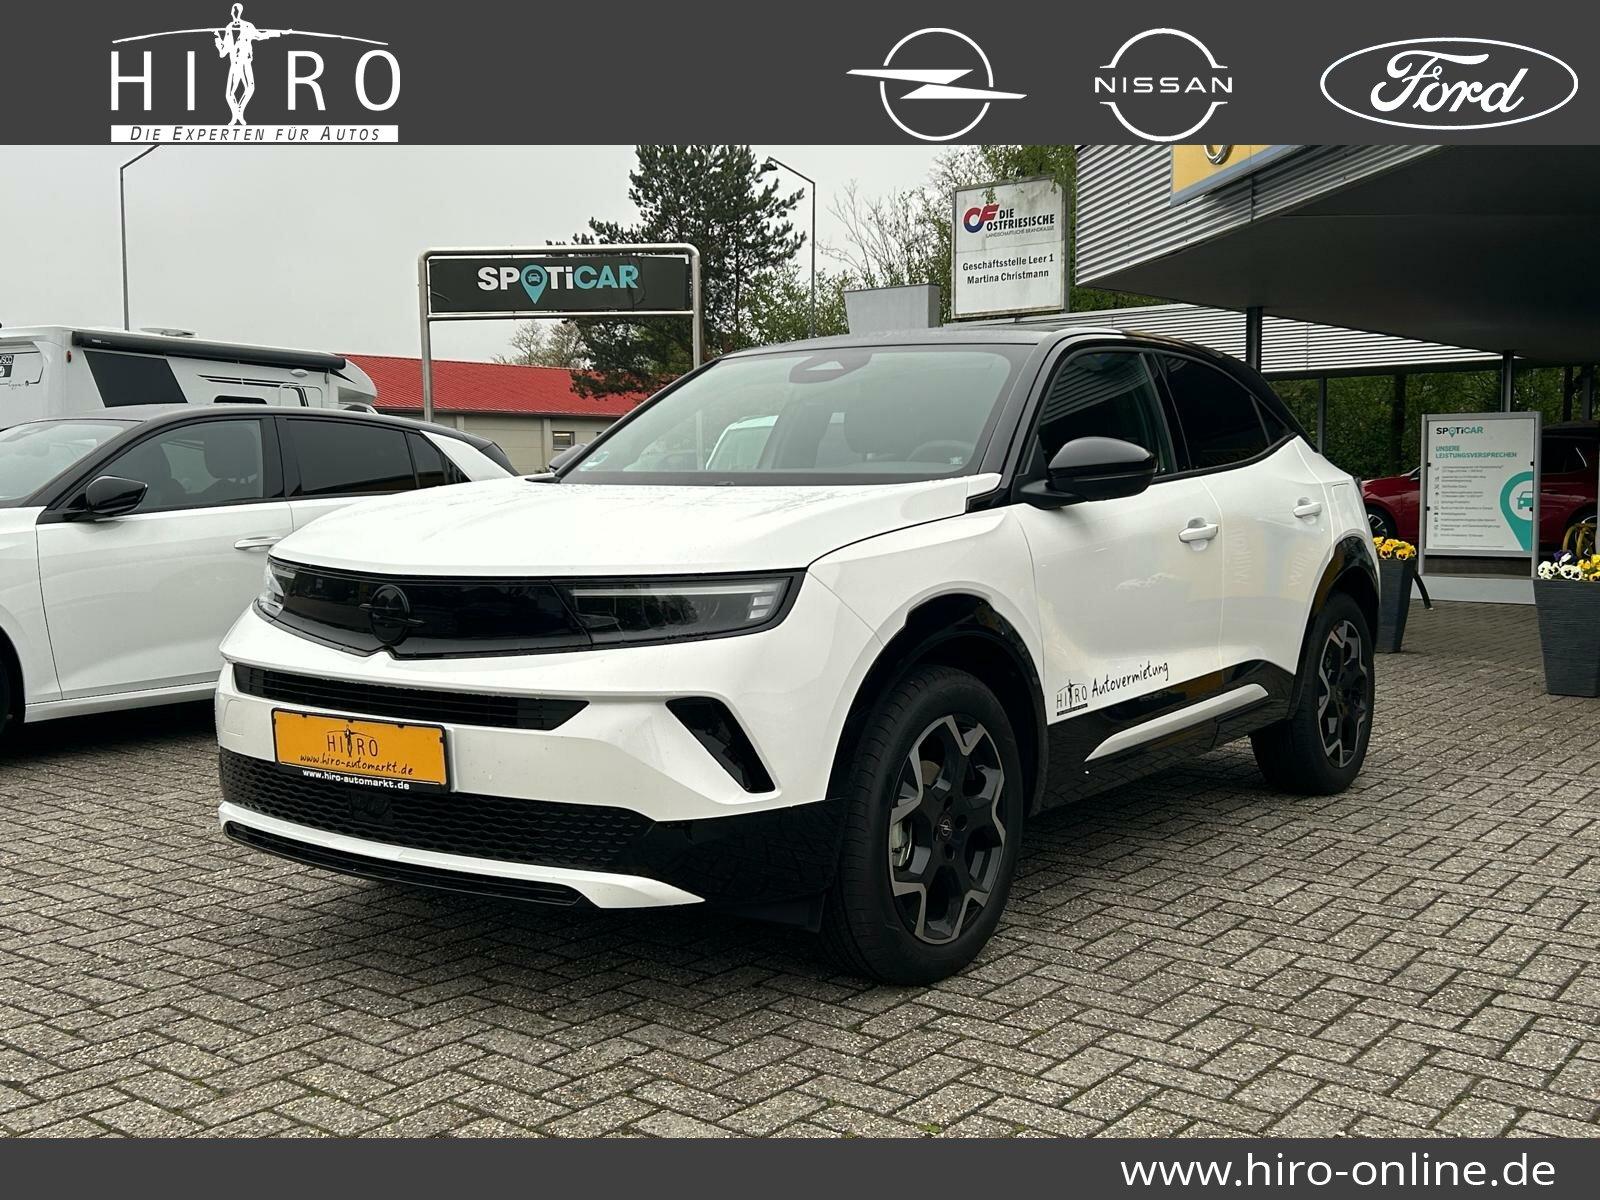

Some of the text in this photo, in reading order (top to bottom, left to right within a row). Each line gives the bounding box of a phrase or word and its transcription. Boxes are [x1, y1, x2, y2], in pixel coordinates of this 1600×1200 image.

[986, 214, 1055, 231] OSTFRIESISCHE
[1000, 208, 1014, 219] DIE
[962, 253, 1054, 271] Geschäftsstelle Leer 1
[967, 270, 1049, 285] Martina Christmann
[1056, 660, 1169, 708] HIRO Autovermietung
[326, 735, 378, 757] HIRO
[300, 753, 413, 776] www.hiro-automarkt.de
[302, 769, 410, 790] www.hiro-automarkt.de
